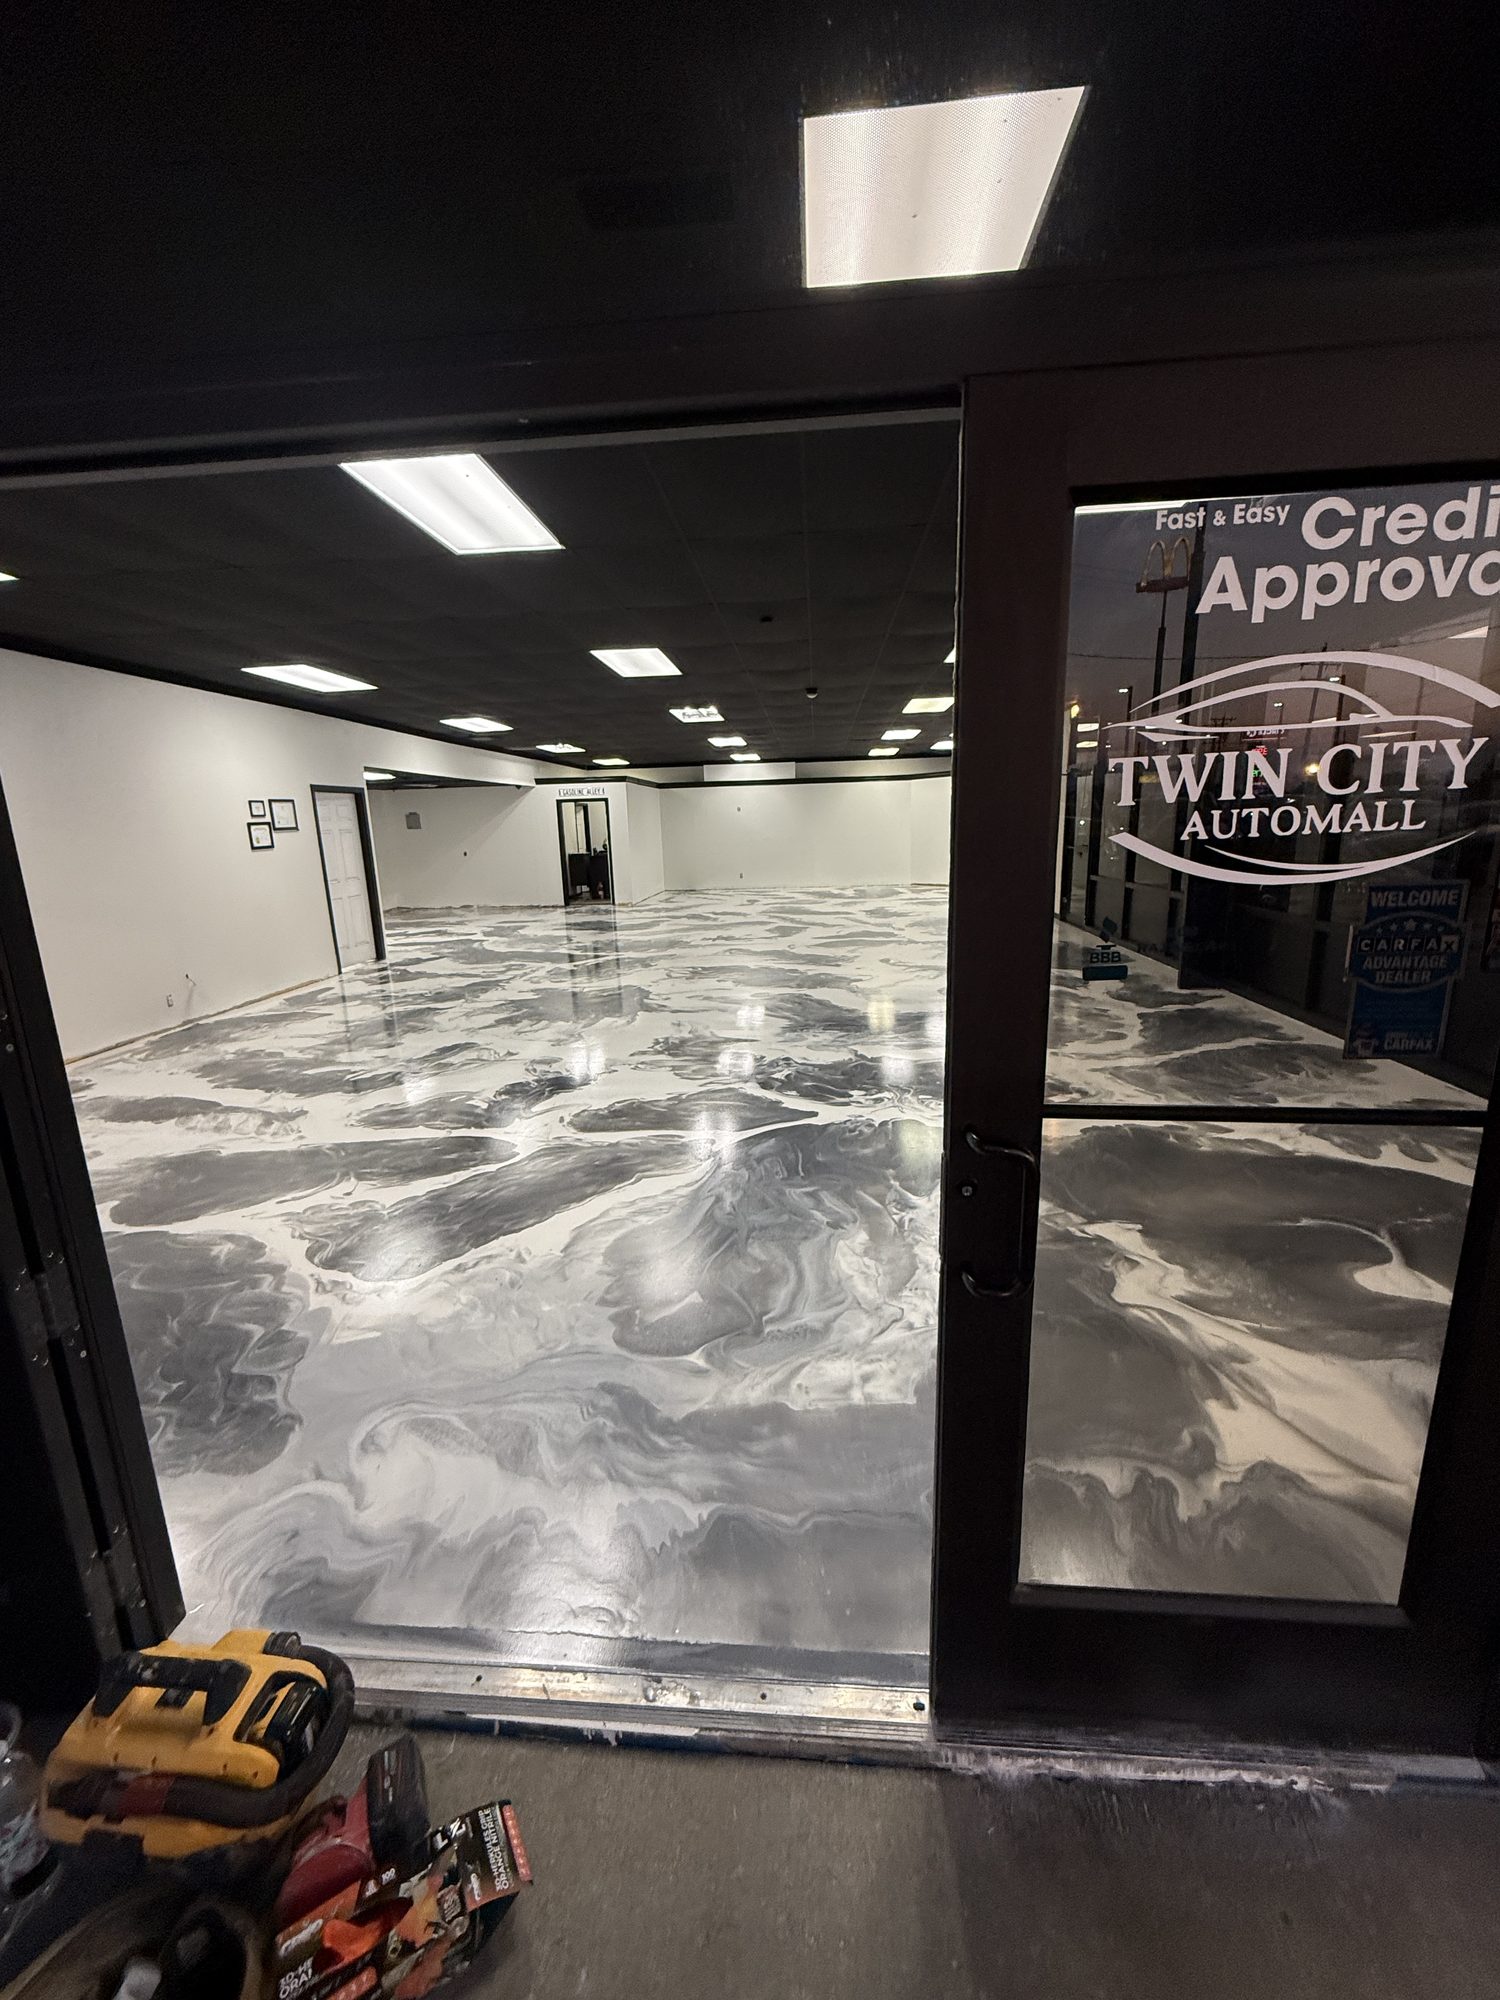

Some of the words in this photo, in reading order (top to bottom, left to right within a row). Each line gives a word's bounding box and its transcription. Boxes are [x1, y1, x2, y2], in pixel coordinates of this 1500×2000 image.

[1155, 507, 1206, 531] Fast
[1213, 510, 1227, 527] &
[1233, 504, 1291, 526] Easy
[1301, 485, 1500, 550] Credi
[1108, 748, 1293, 807] TWIN
[1317, 738, 1489, 796] CITY
[1180, 800, 1426, 841] AUTOMALL
[1370, 889, 1459, 908] WELCOME
[1090, 951, 1121, 963] BBB
[1359, 936, 1458, 952] CARFAX
[1362, 954, 1448, 970] ADVANTAGE
[1375, 969, 1431, 984] DEALER
[483, 1807, 498, 1844] NITRILE
[493, 1846, 509, 1889] ORANGE
